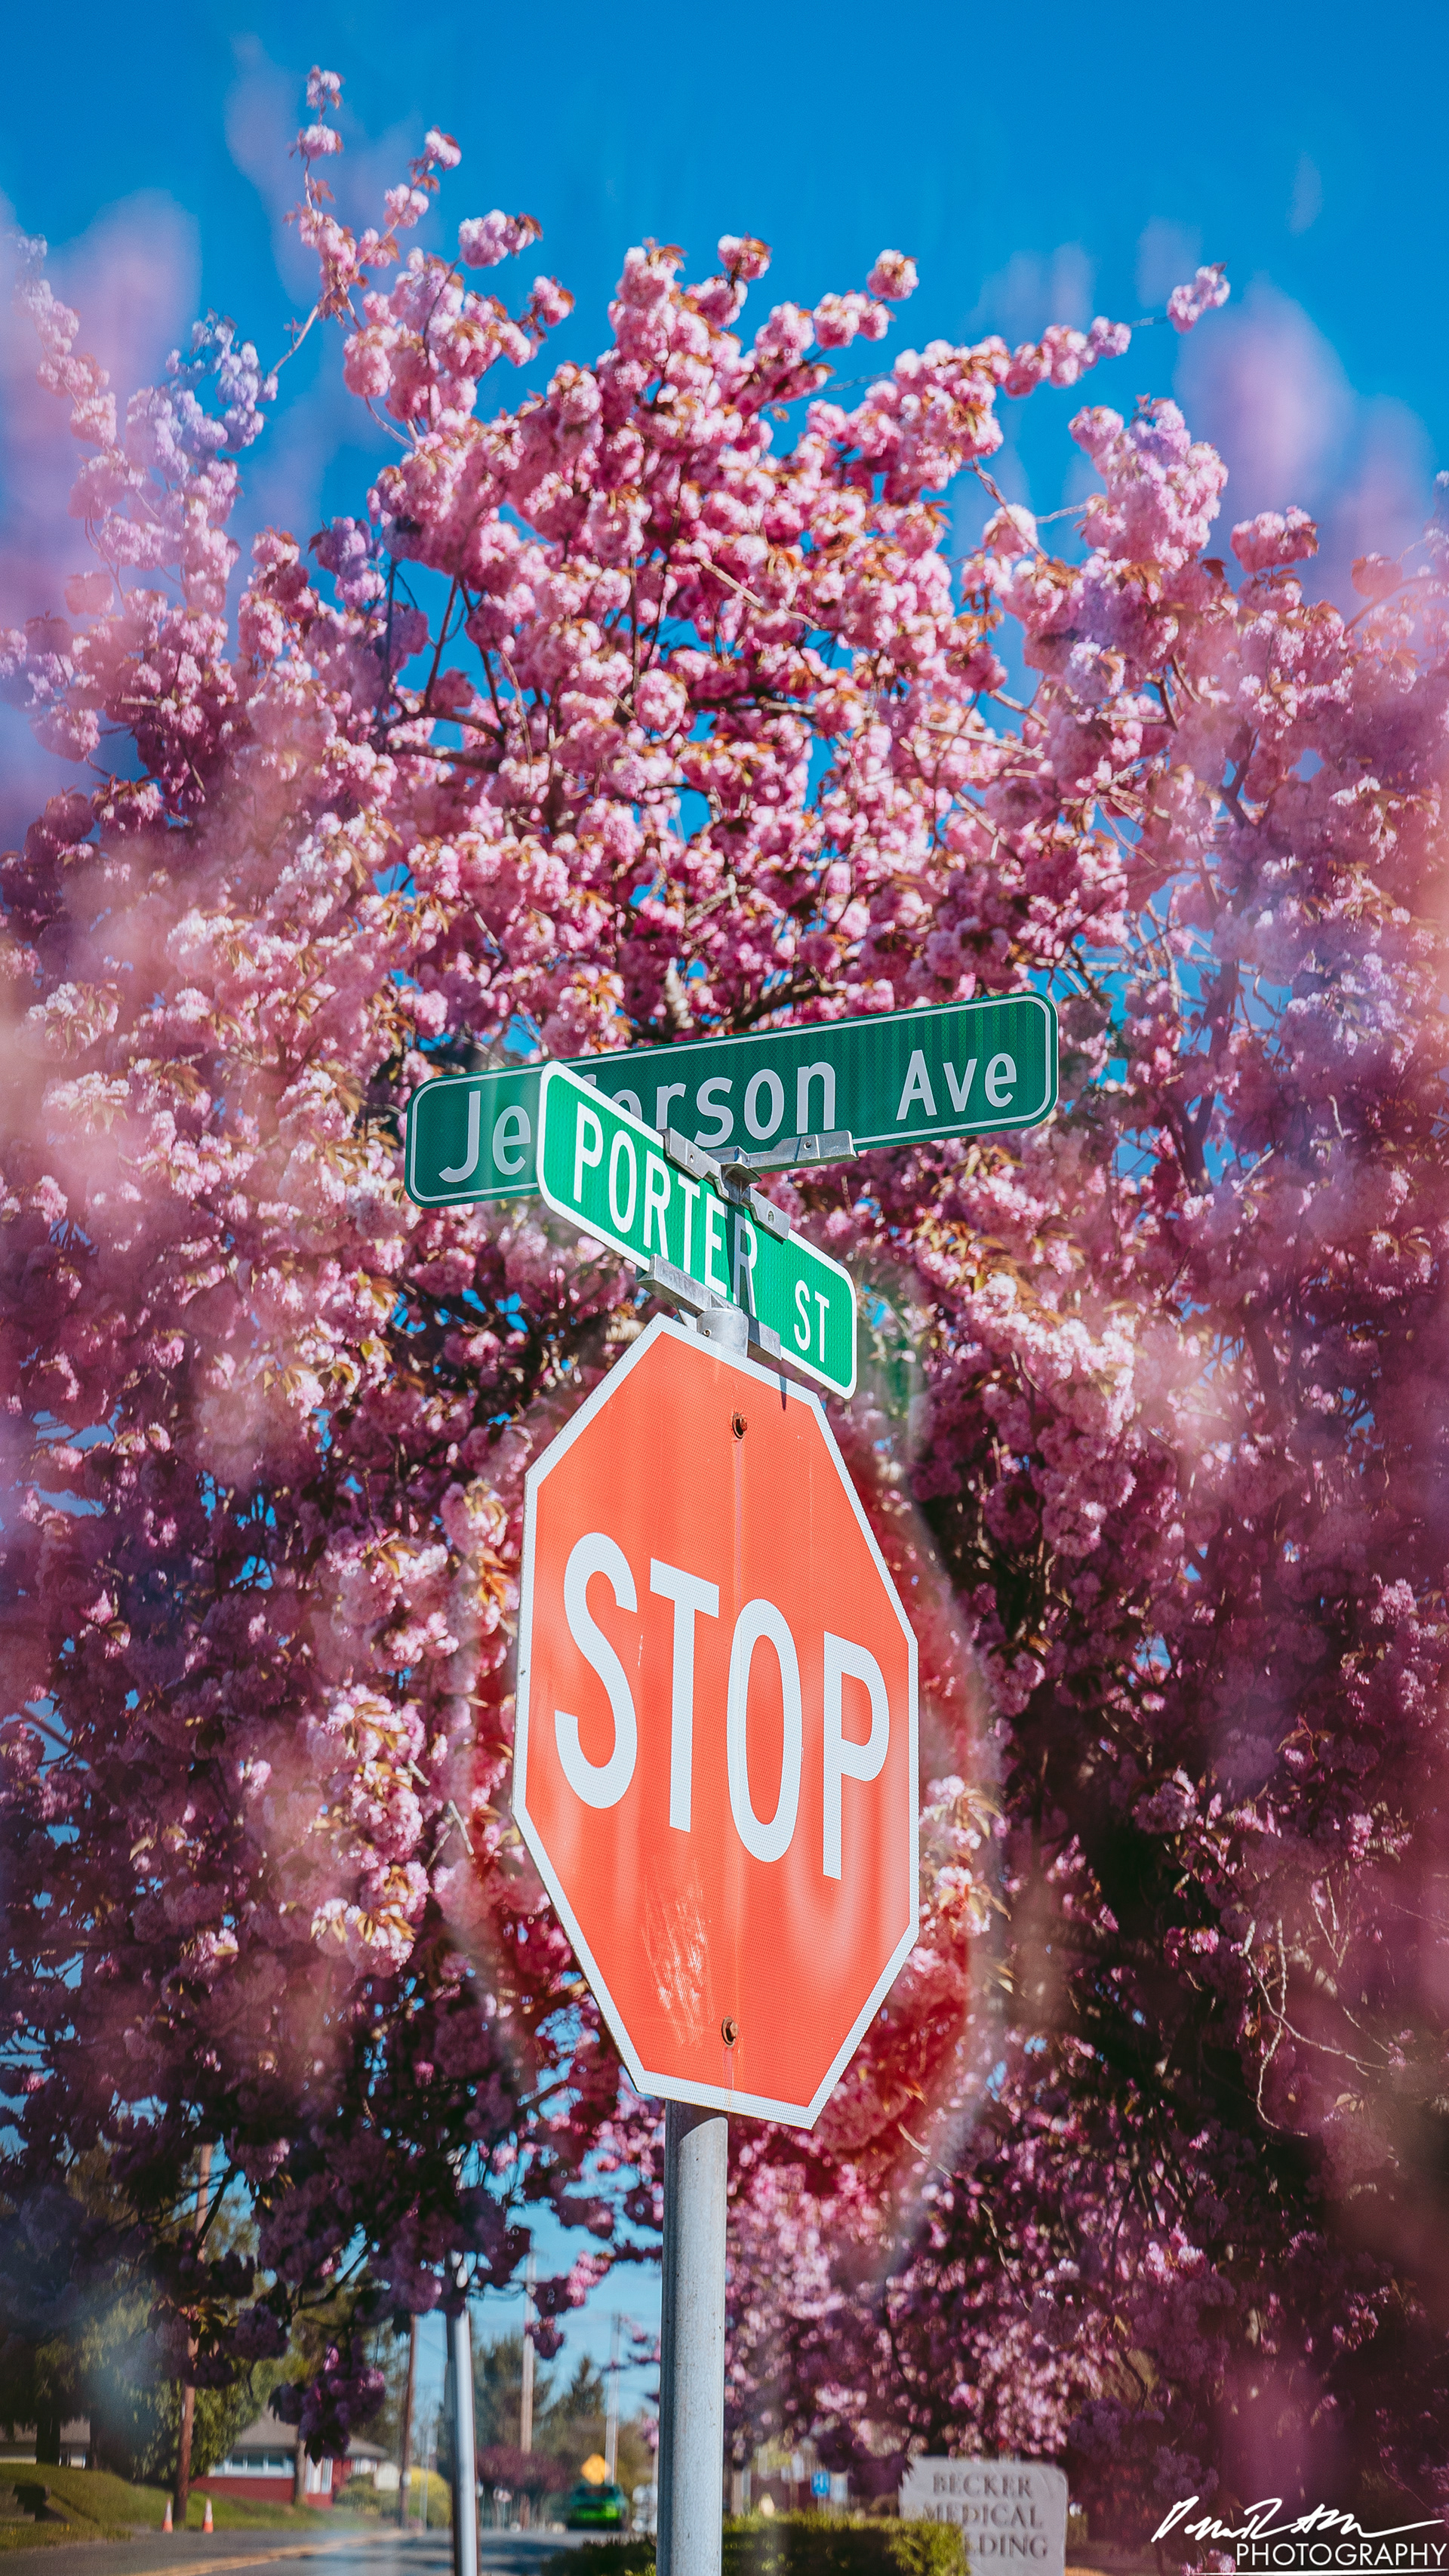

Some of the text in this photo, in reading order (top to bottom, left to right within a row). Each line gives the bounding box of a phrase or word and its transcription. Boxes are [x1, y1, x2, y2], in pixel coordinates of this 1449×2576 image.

[438, 1049, 1018, 1183] Jerson Ave
[574, 1101, 829, 1362] PORTER ST
[554, 1532, 891, 1880] STOP
[922, 2501, 1043, 2528] MEDICAL
[934, 2471, 1032, 2498] BECKER
[964, 2533, 1048, 2559] LDING
